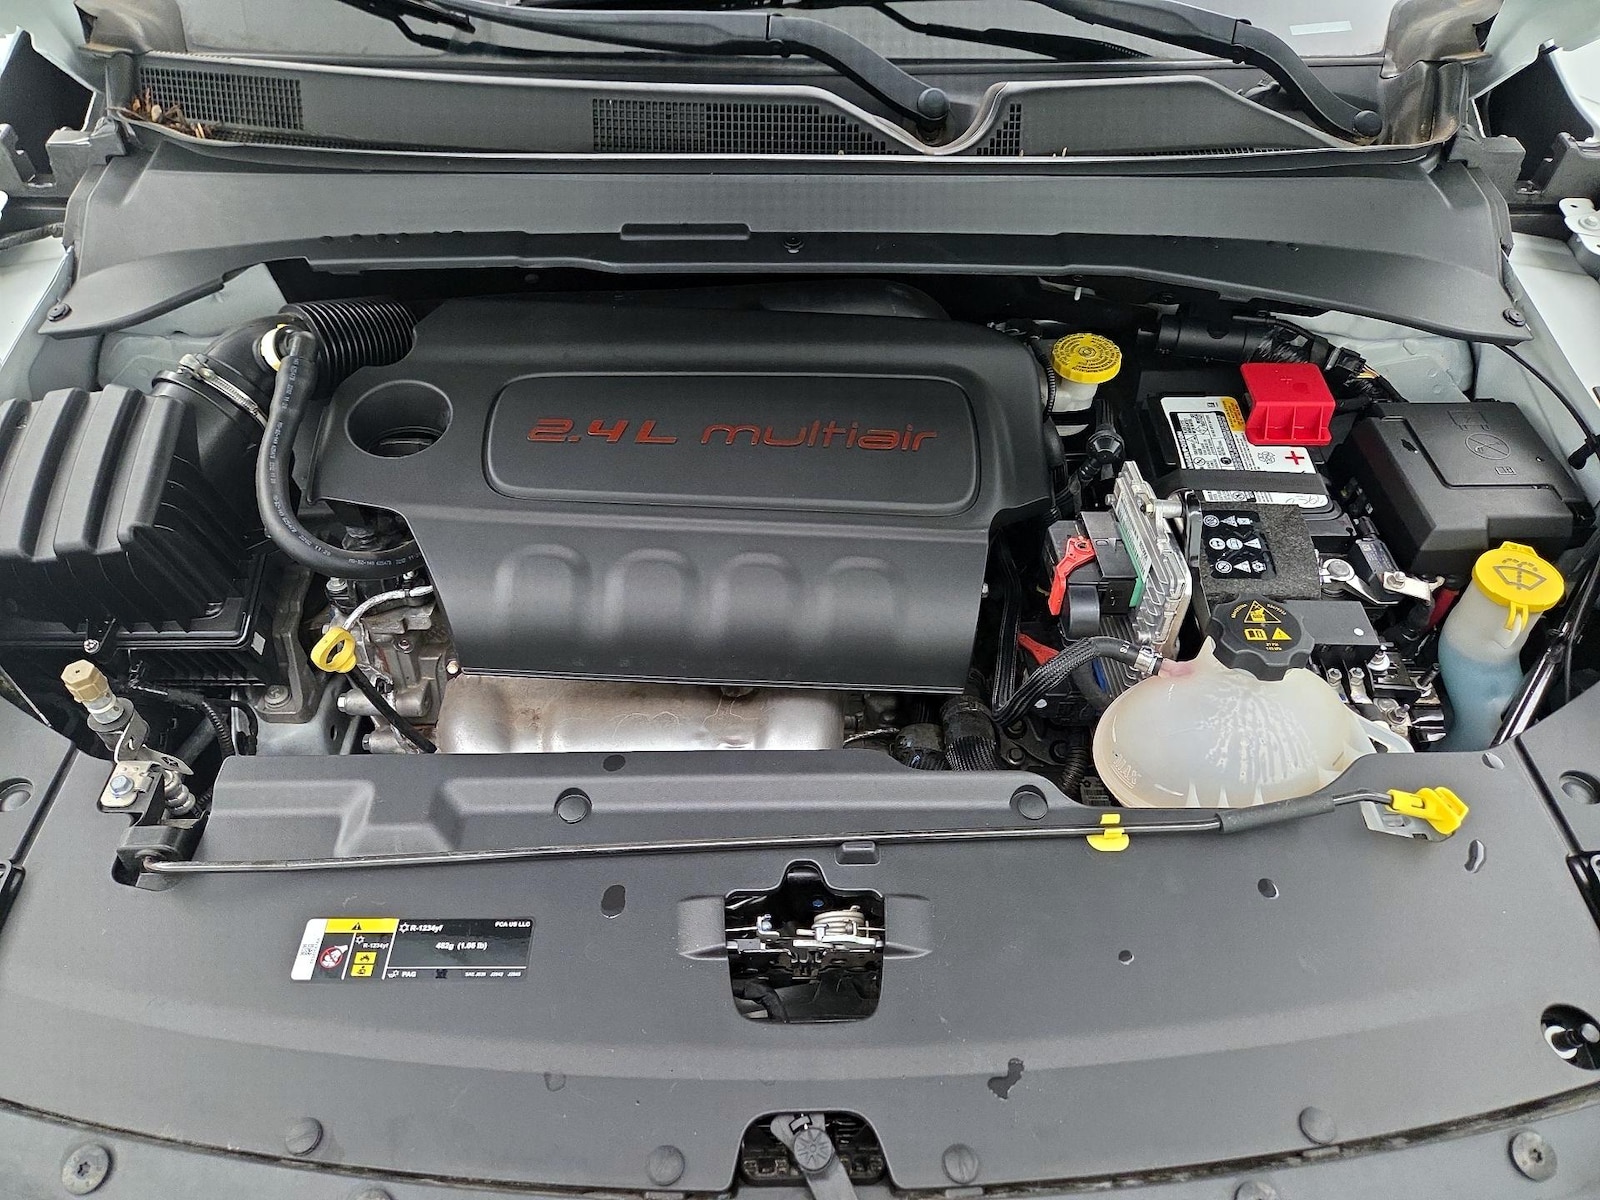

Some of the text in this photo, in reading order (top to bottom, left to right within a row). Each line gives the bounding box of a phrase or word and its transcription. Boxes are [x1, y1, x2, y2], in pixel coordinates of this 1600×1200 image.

[700, 420, 938, 452] multiair
[409, 923, 443, 933] R-1234yf
[362, 941, 389, 950] R-1234yf
